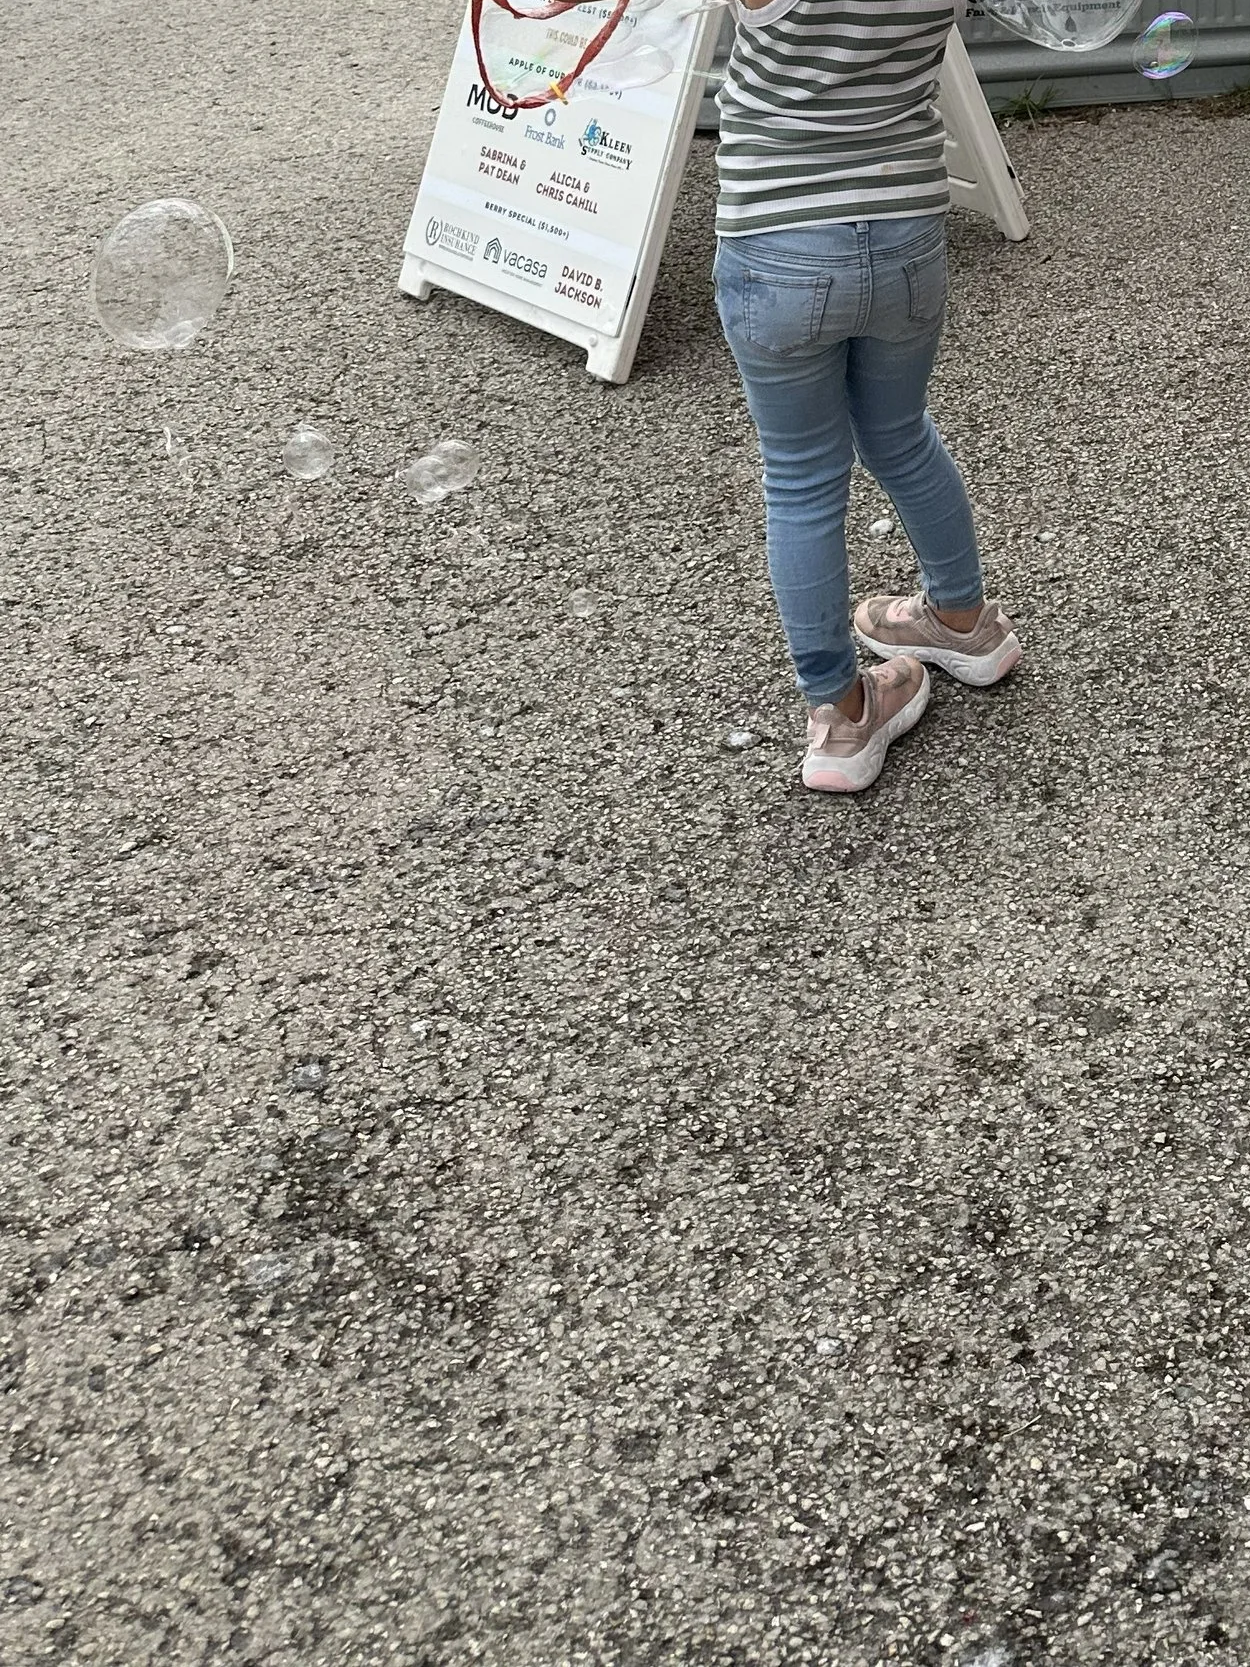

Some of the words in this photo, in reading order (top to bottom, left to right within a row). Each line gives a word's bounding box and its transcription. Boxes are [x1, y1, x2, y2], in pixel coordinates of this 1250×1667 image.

[508, 57, 534, 72] APPLE
[535, 65, 548, 75] OF
[466, 83, 519, 121] MOD
[523, 124, 546, 144] Frost
[546, 129, 566, 150] Bank
[599, 131, 632, 155] KLEEN
[480, 146, 518, 169] SABRINA
[519, 159, 527, 171] &
[478, 162, 496, 177] PAT
[496, 167, 520, 185] DEAN
[549, 170, 581, 190] ALICIA
[583, 181, 591, 193] &
[535, 182, 564, 202] CHRIS
[565, 192, 599, 215] CAHILL
[484, 201, 507, 216] BERRY
[508, 209, 536, 227] SPECIAL
[440, 233, 478, 256] INSURANCE
[503, 248, 548, 279] vacasa
[561, 265, 593, 287] DAVID
[594, 278, 603, 292] B.
[554, 281, 602, 310] JACKSON
